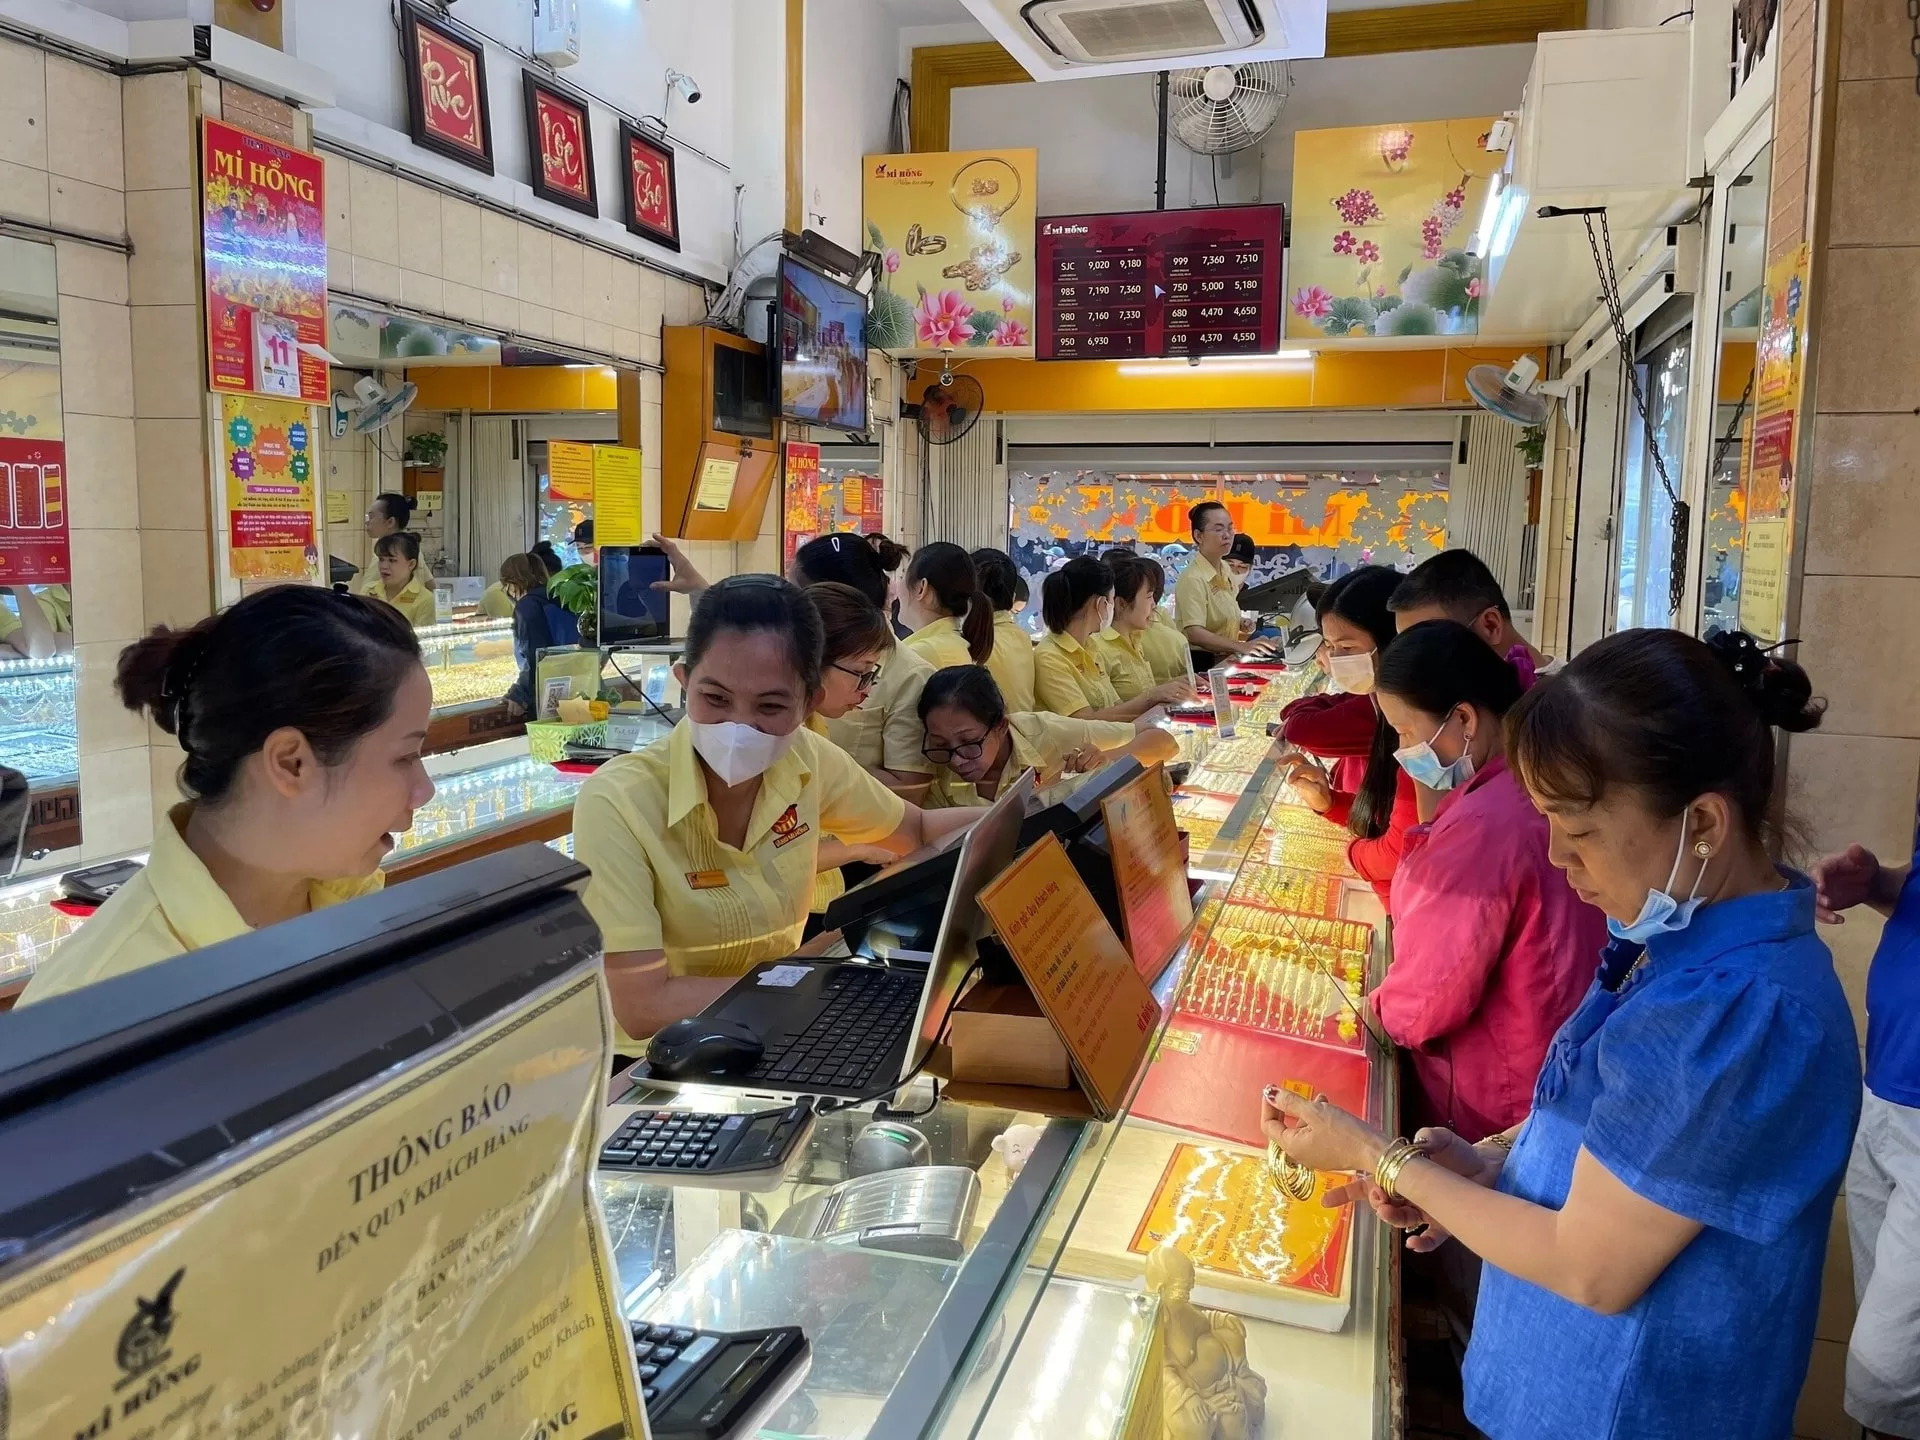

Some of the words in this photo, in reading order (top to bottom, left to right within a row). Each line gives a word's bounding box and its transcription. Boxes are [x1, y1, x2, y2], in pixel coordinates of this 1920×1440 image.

[1061, 262, 1075, 271] SJC
[1088, 260, 1110, 271] 9,020
[1119, 259, 1142, 270] 9,180
[1173, 257, 1189, 266] 999
[1202, 255, 1225, 266] 7,360
[1235, 254, 1259, 264] 7,510
[1060, 287, 1075, 296] 985
[1088, 286, 1110, 296] 7,190
[1119, 285, 1141, 295] 7,360
[1172, 283, 1188, 292] 750
[1201, 281, 1225, 292] 5,000
[1234, 280, 1258, 290] 5,180
[1060, 312, 1075, 321] 980
[1087, 311, 1110, 322] 7,160
[1119, 310, 1141, 321] 7,330
[1171, 308, 1187, 317] 680
[1200, 307, 1224, 318] 4,470
[1233, 306, 1257, 317] 4,650
[1060, 337, 1075, 346] 950
[1087, 336, 1109, 346] 6,930
[1127, 336, 1131, 345] 1
[1171, 334, 1187, 343] 610
[1199, 333, 1223, 343] 4,370
[1232, 332, 1256, 342] 4,550
[267, 335, 290, 367] 11
[278, 376, 286, 389] 4
[349, 1117, 453, 1205] THÔNG
[460, 1081, 512, 1136] BÁO
[414, 1144, 481, 1205] KHÁCH
[483, 1113, 532, 1158] HÀNG
[416, 1402, 451, 1434] trong
[452, 1377, 476, 1404] việc
[478, 1361, 497, 1381] xác
[499, 1334, 525, 1364] nhận
[526, 1309, 560, 1341] chứng
[466, 1402, 488, 1429] hợp
[490, 1383, 506, 1406] tác
[510, 1366, 530, 1388] của
[556, 1313, 596, 1348] Khách
